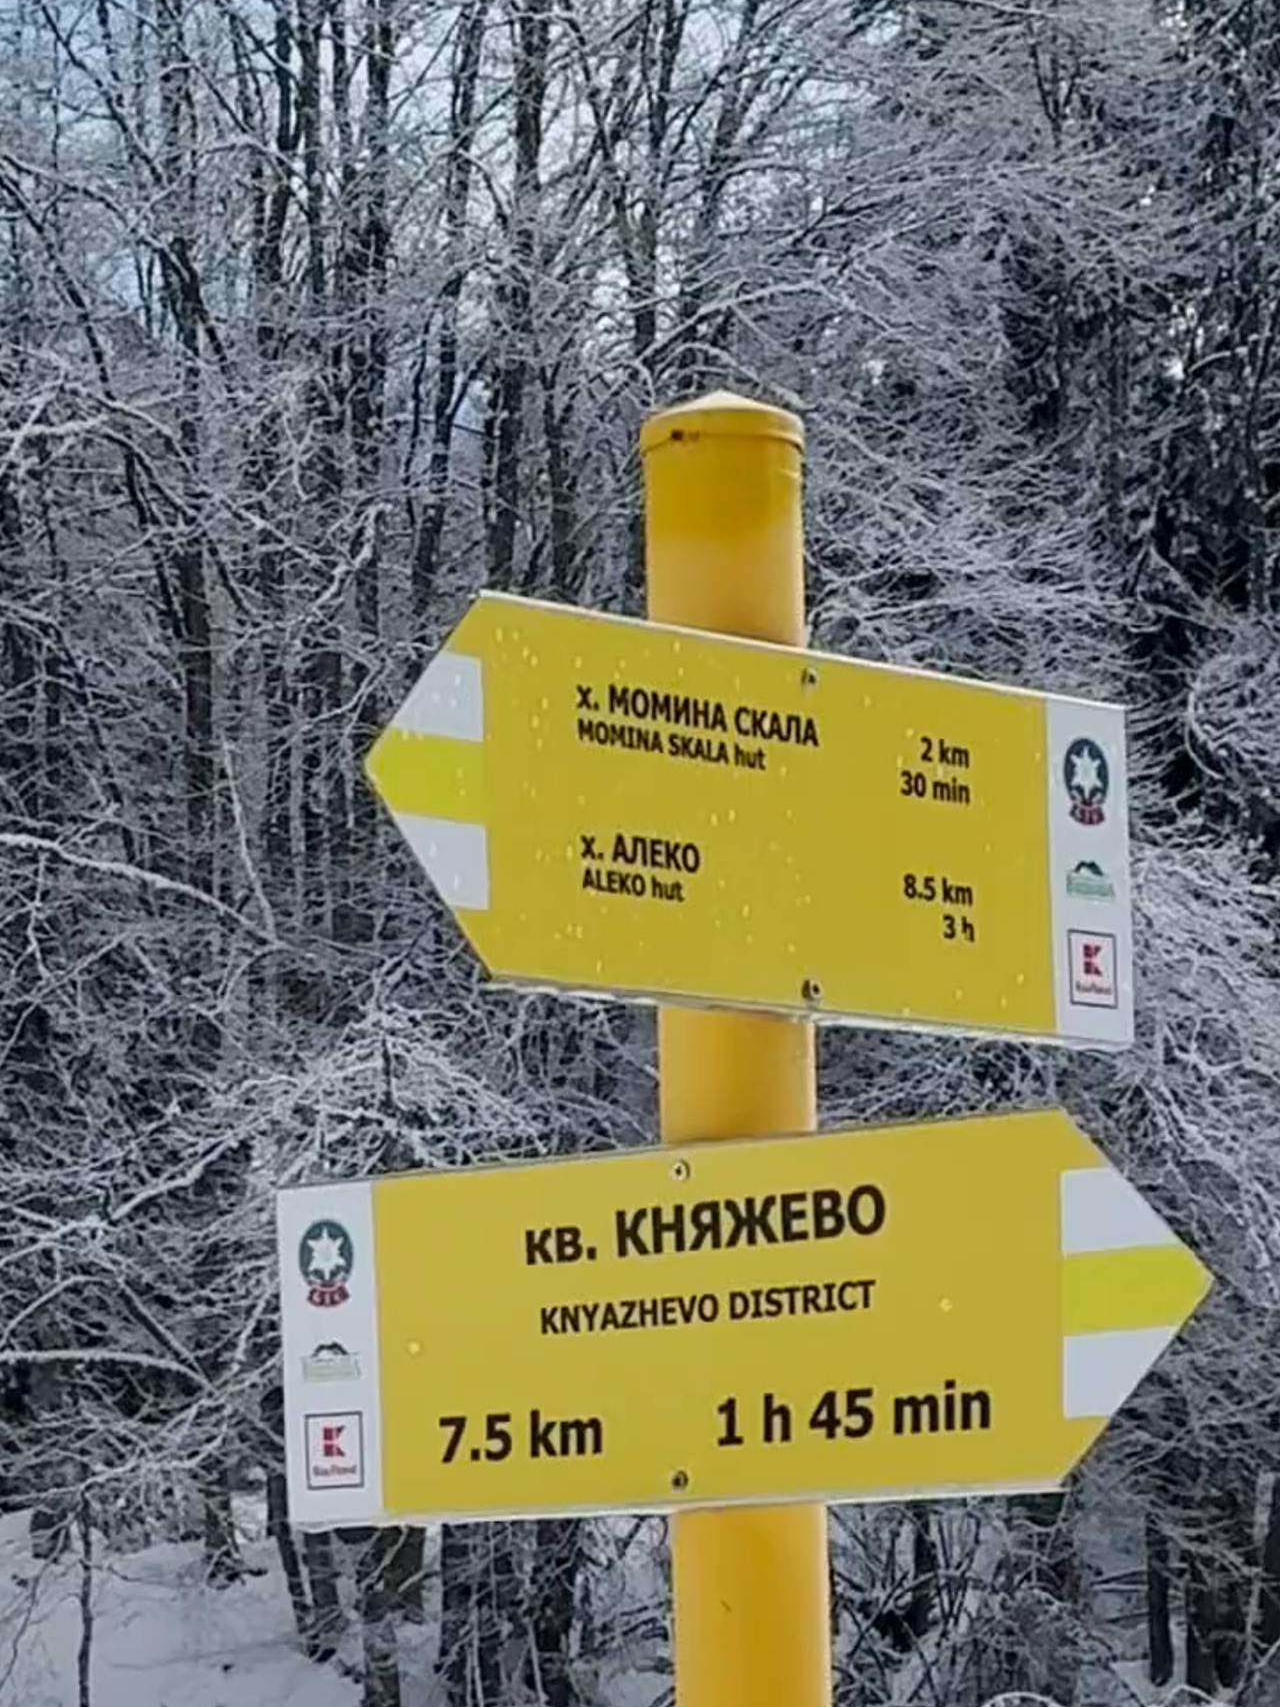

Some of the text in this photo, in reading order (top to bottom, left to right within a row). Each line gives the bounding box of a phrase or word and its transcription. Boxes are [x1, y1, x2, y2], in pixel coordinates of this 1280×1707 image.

[577, 685, 819, 748] х. МОМИНА СКАЛА
[578, 718, 766, 770] MOMINA SKALA hut
[920, 737, 970, 768] 2 km
[900, 771, 970, 804] 30 min
[581, 834, 700, 873] х. АЛЕКО
[583, 868, 684, 902] ALEKO hut
[903, 874, 973, 905] 8.5 km
[942, 915, 975, 942] 3 h
[525, 1185, 886, 1265] кв. КНЯЖЕВО
[540, 1280, 876, 1334] KNYAZHEVO DISTRICT
[717, 1380, 991, 1446] 1 h 45 min
[439, 1410, 603, 1463] 7.5 km
